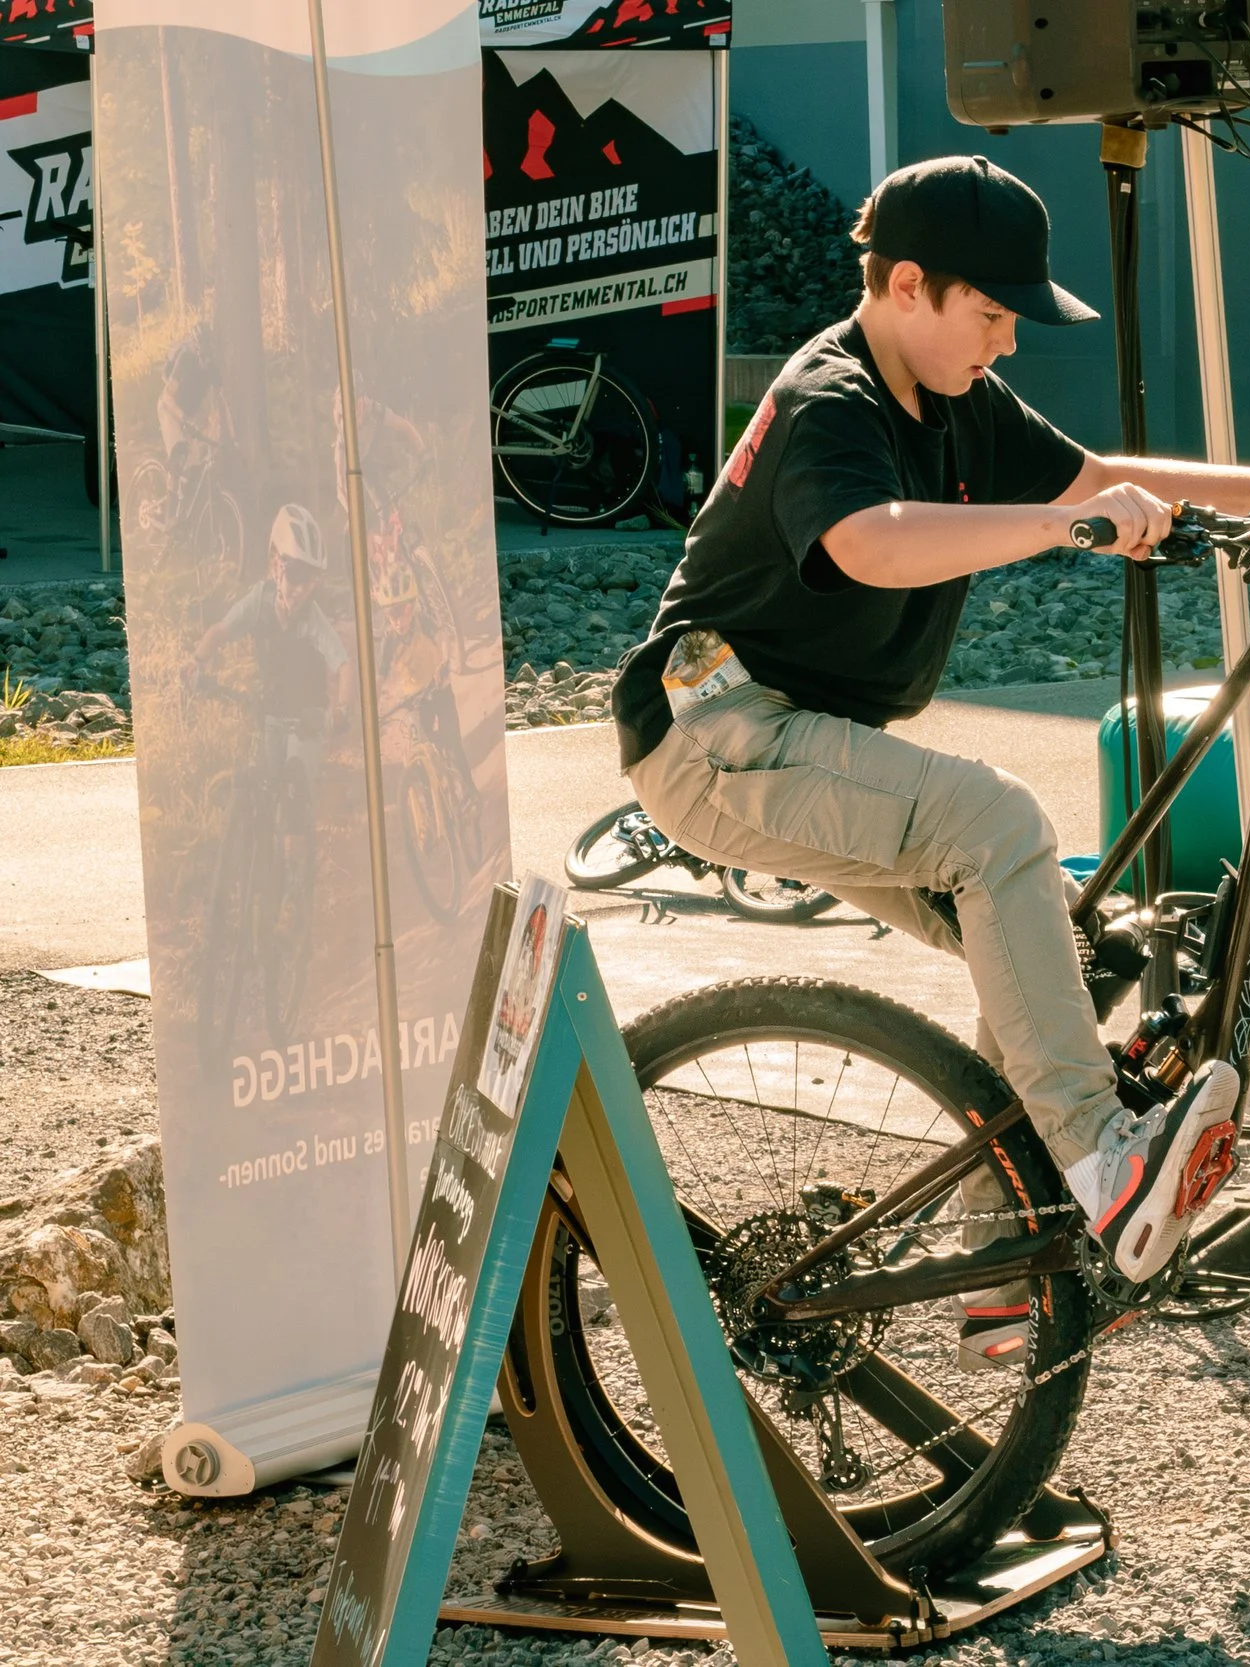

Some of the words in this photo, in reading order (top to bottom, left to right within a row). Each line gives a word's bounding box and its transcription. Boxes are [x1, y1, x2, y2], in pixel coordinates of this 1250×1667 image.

[496, 1, 559, 24] EMMENTAL
[535, 194, 586, 231] DEIN
[588, 183, 640, 221] BIKE
[518, 237, 562, 271] UND
[565, 210, 698, 264] PERSÖNLICH
